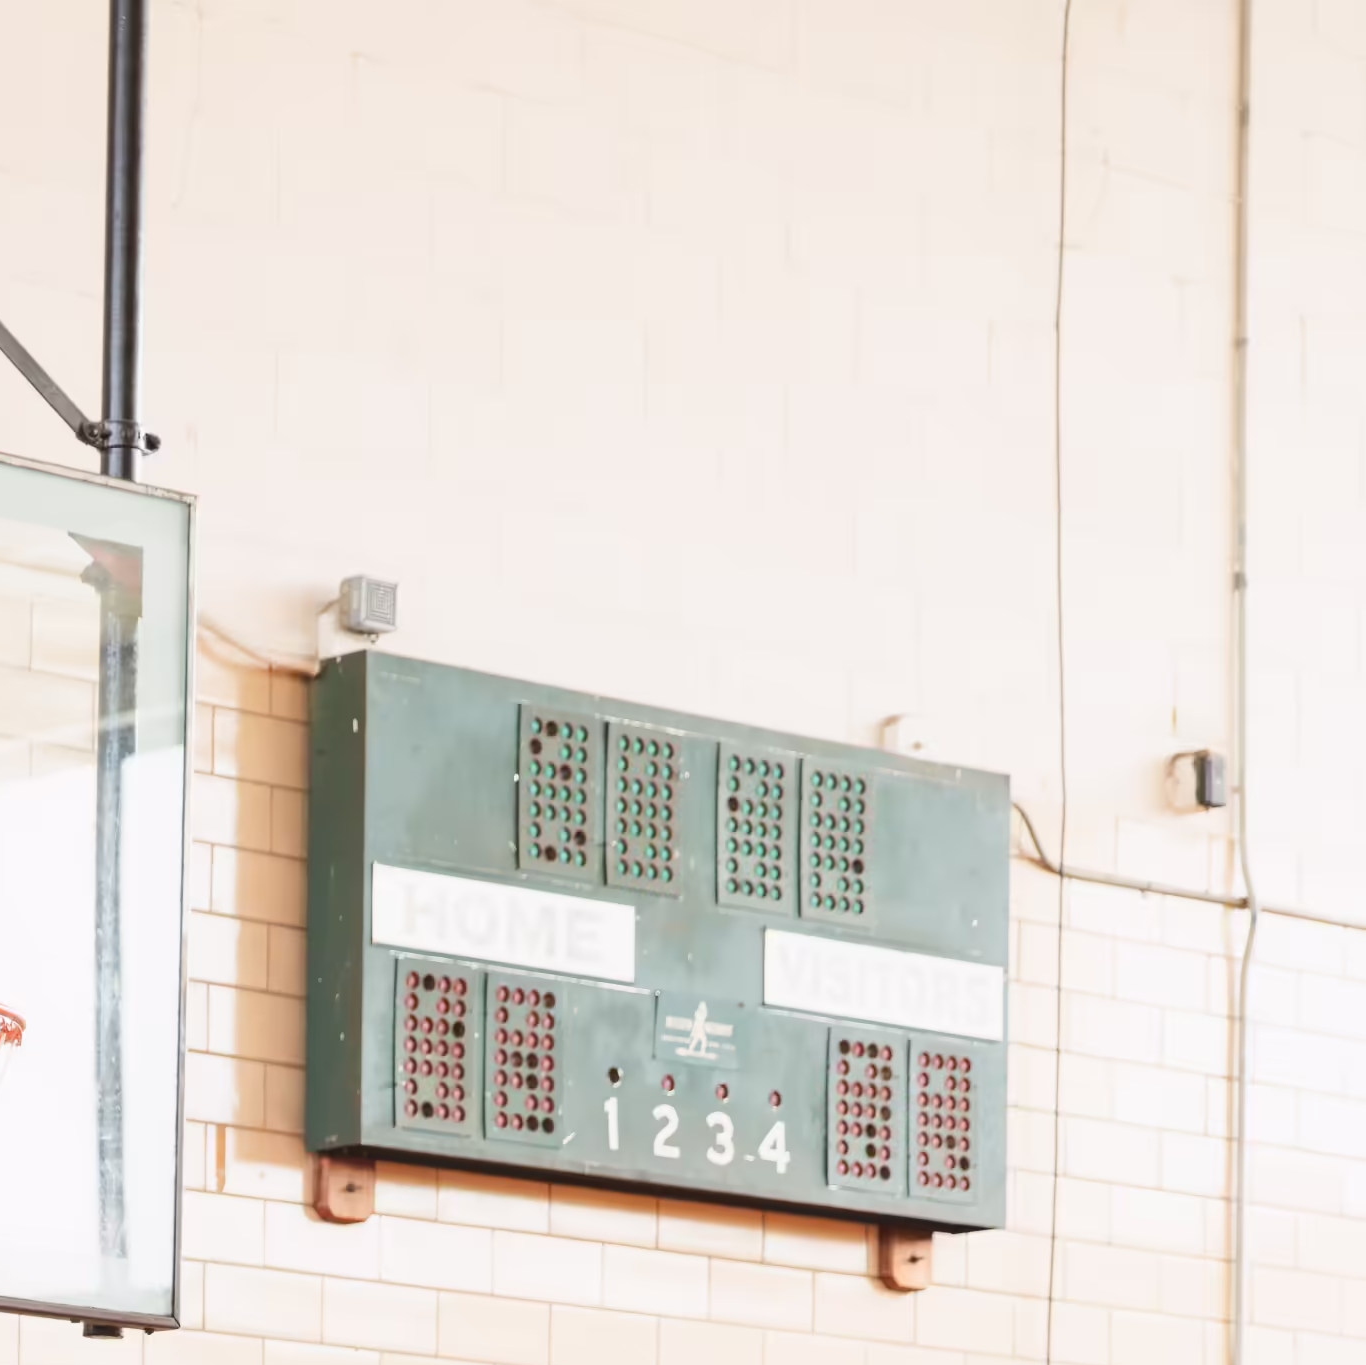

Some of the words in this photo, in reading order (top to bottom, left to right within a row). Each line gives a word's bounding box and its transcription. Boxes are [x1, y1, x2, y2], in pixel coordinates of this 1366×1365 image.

[401, 882, 605, 962] HOME
[776, 942, 990, 1028] VISITORS
[604, 1096, 619, 1151] 1
[652, 1104, 681, 1159] 2
[706, 1111, 735, 1166] 3
[757, 1120, 791, 1174] 4
